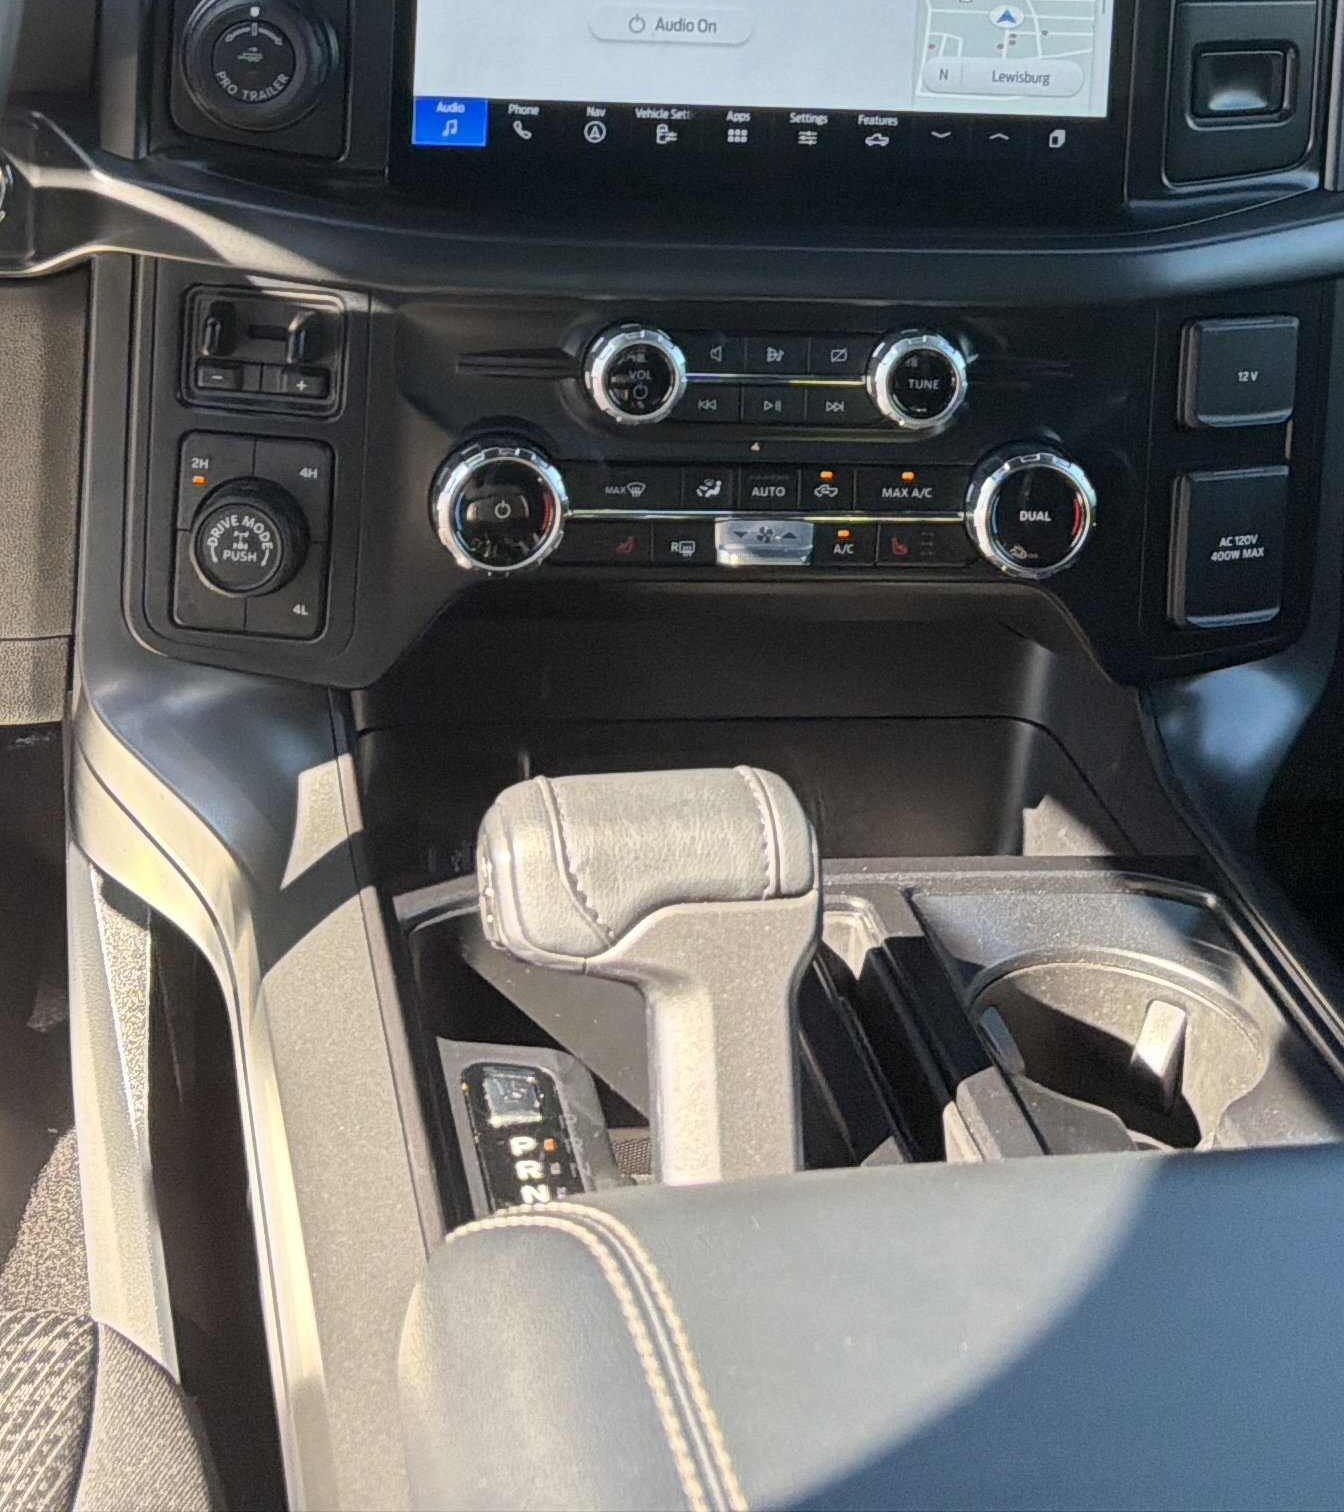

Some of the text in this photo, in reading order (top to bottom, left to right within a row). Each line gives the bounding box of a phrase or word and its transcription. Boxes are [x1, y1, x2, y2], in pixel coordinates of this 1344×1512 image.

[655, 15, 718, 34] Audio On
[938, 68, 950, 81] N
[991, 69, 1051, 87] Lewisburg
[216, 70, 290, 102] PRO TRAILER
[436, 101, 466, 114] Audio
[507, 103, 540, 116] Phone
[586, 105, 607, 118] Nav
[634, 106, 669, 120] Vehicle
[725, 109, 751, 123] Apps
[789, 111, 829, 127] Settings
[857, 114, 899, 128] Features
[628, 368, 653, 382] VOL
[1238, 370, 1259, 382] 12 V
[907, 378, 940, 390] TUNE
[190, 457, 209, 470] 2H
[299, 467, 318, 479] 4H
[605, 485, 626, 495] MAX
[751, 486, 786, 498] AUTO
[881, 487, 933, 499] MAX A/C
[1018, 509, 1052, 523] DUAL
[207, 514, 274, 550] DRIVE MODE
[1219, 533, 1259, 548] AC 120V
[833, 543, 855, 555] A/C
[1210, 547, 1265, 562] 400W MAX
[222, 550, 258, 563] PUSH
[292, 604, 309, 616] 4L
[508, 1135, 537, 1157] P
[514, 1159, 545, 1181] R
[519, 1184, 551, 1204] N
